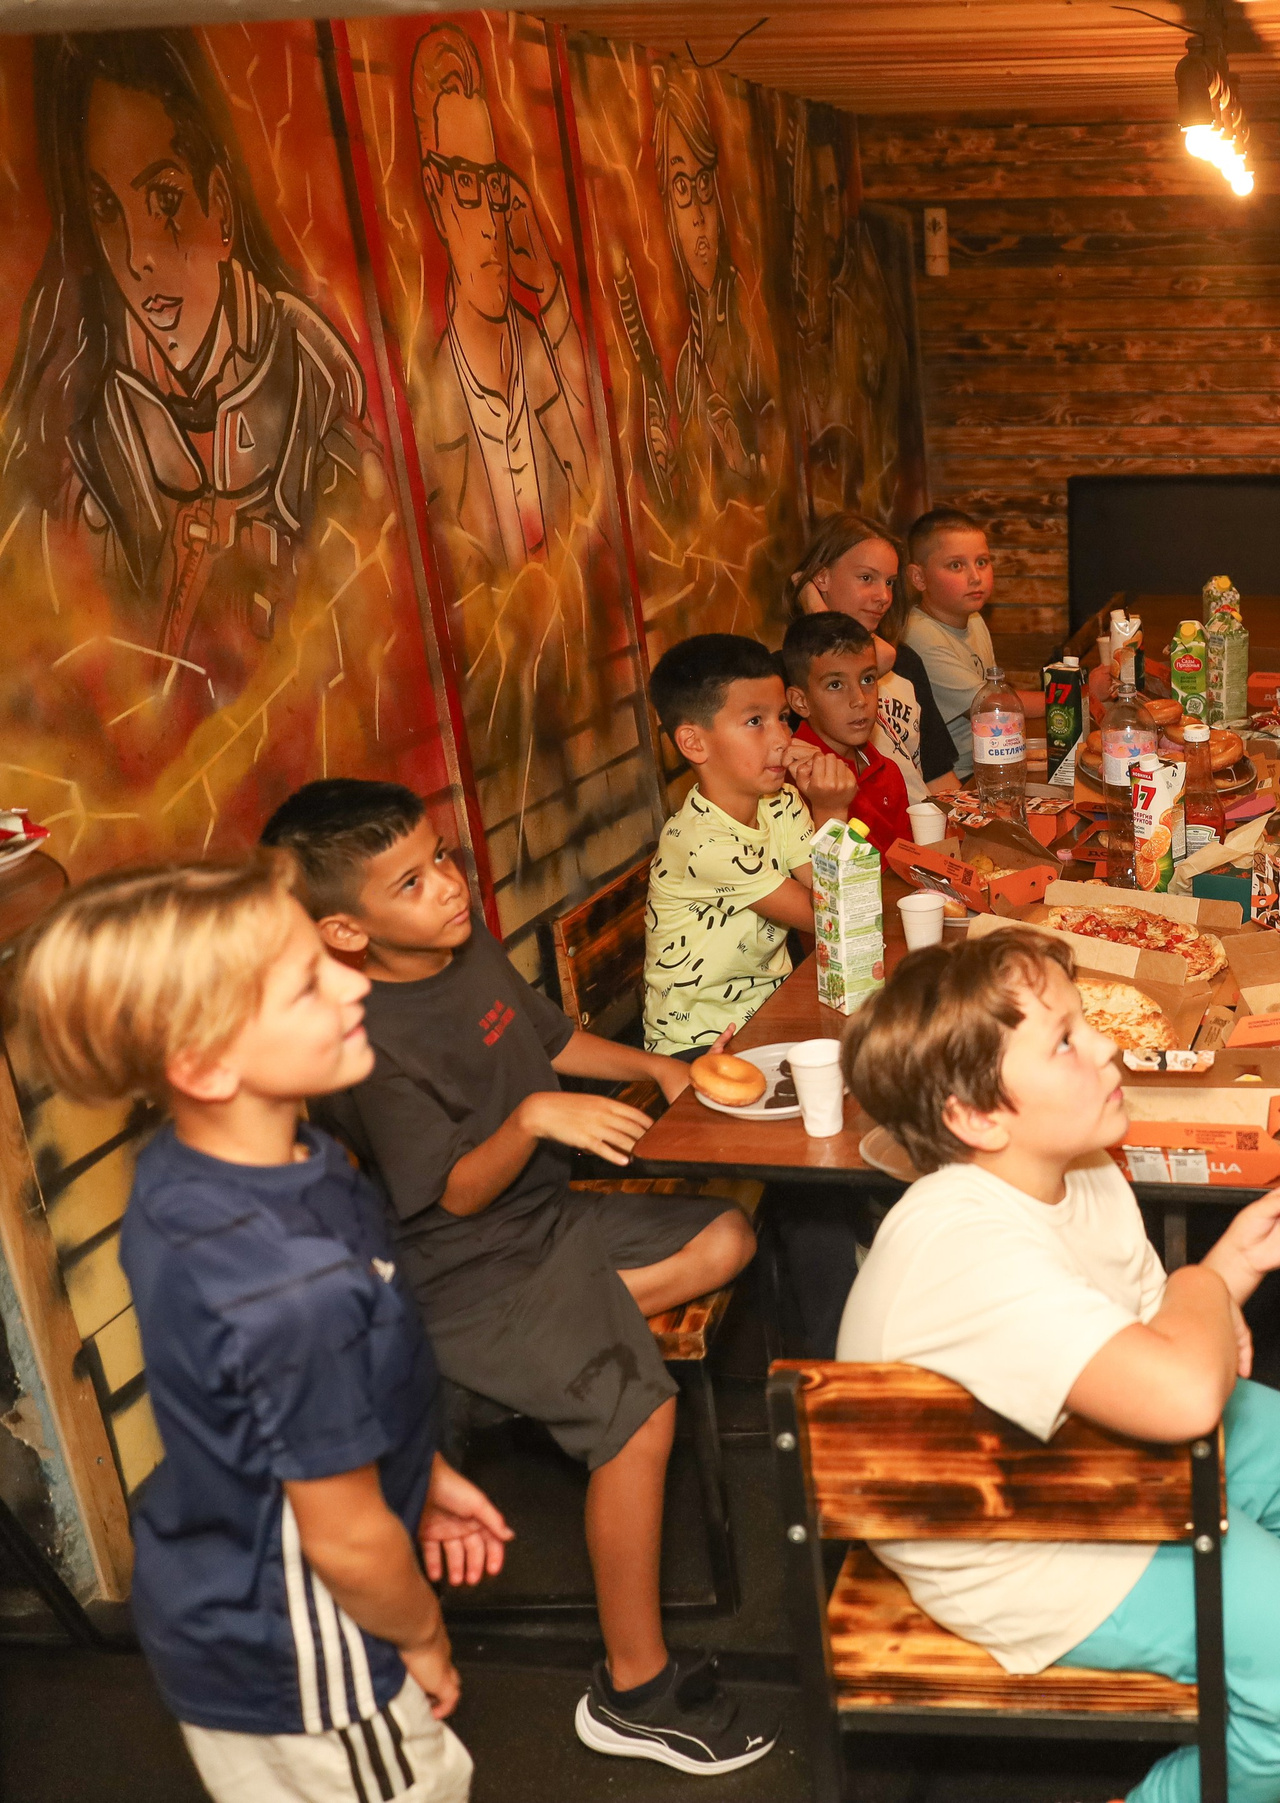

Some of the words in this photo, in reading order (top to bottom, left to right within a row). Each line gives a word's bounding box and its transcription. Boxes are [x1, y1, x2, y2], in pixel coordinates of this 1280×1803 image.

[1046, 682, 1072, 704] J7
[1132, 783, 1157, 811] J7
[1133, 811, 1153, 820] НЕРГИЯ
[1133, 816, 1153, 826] РУКТОВ
